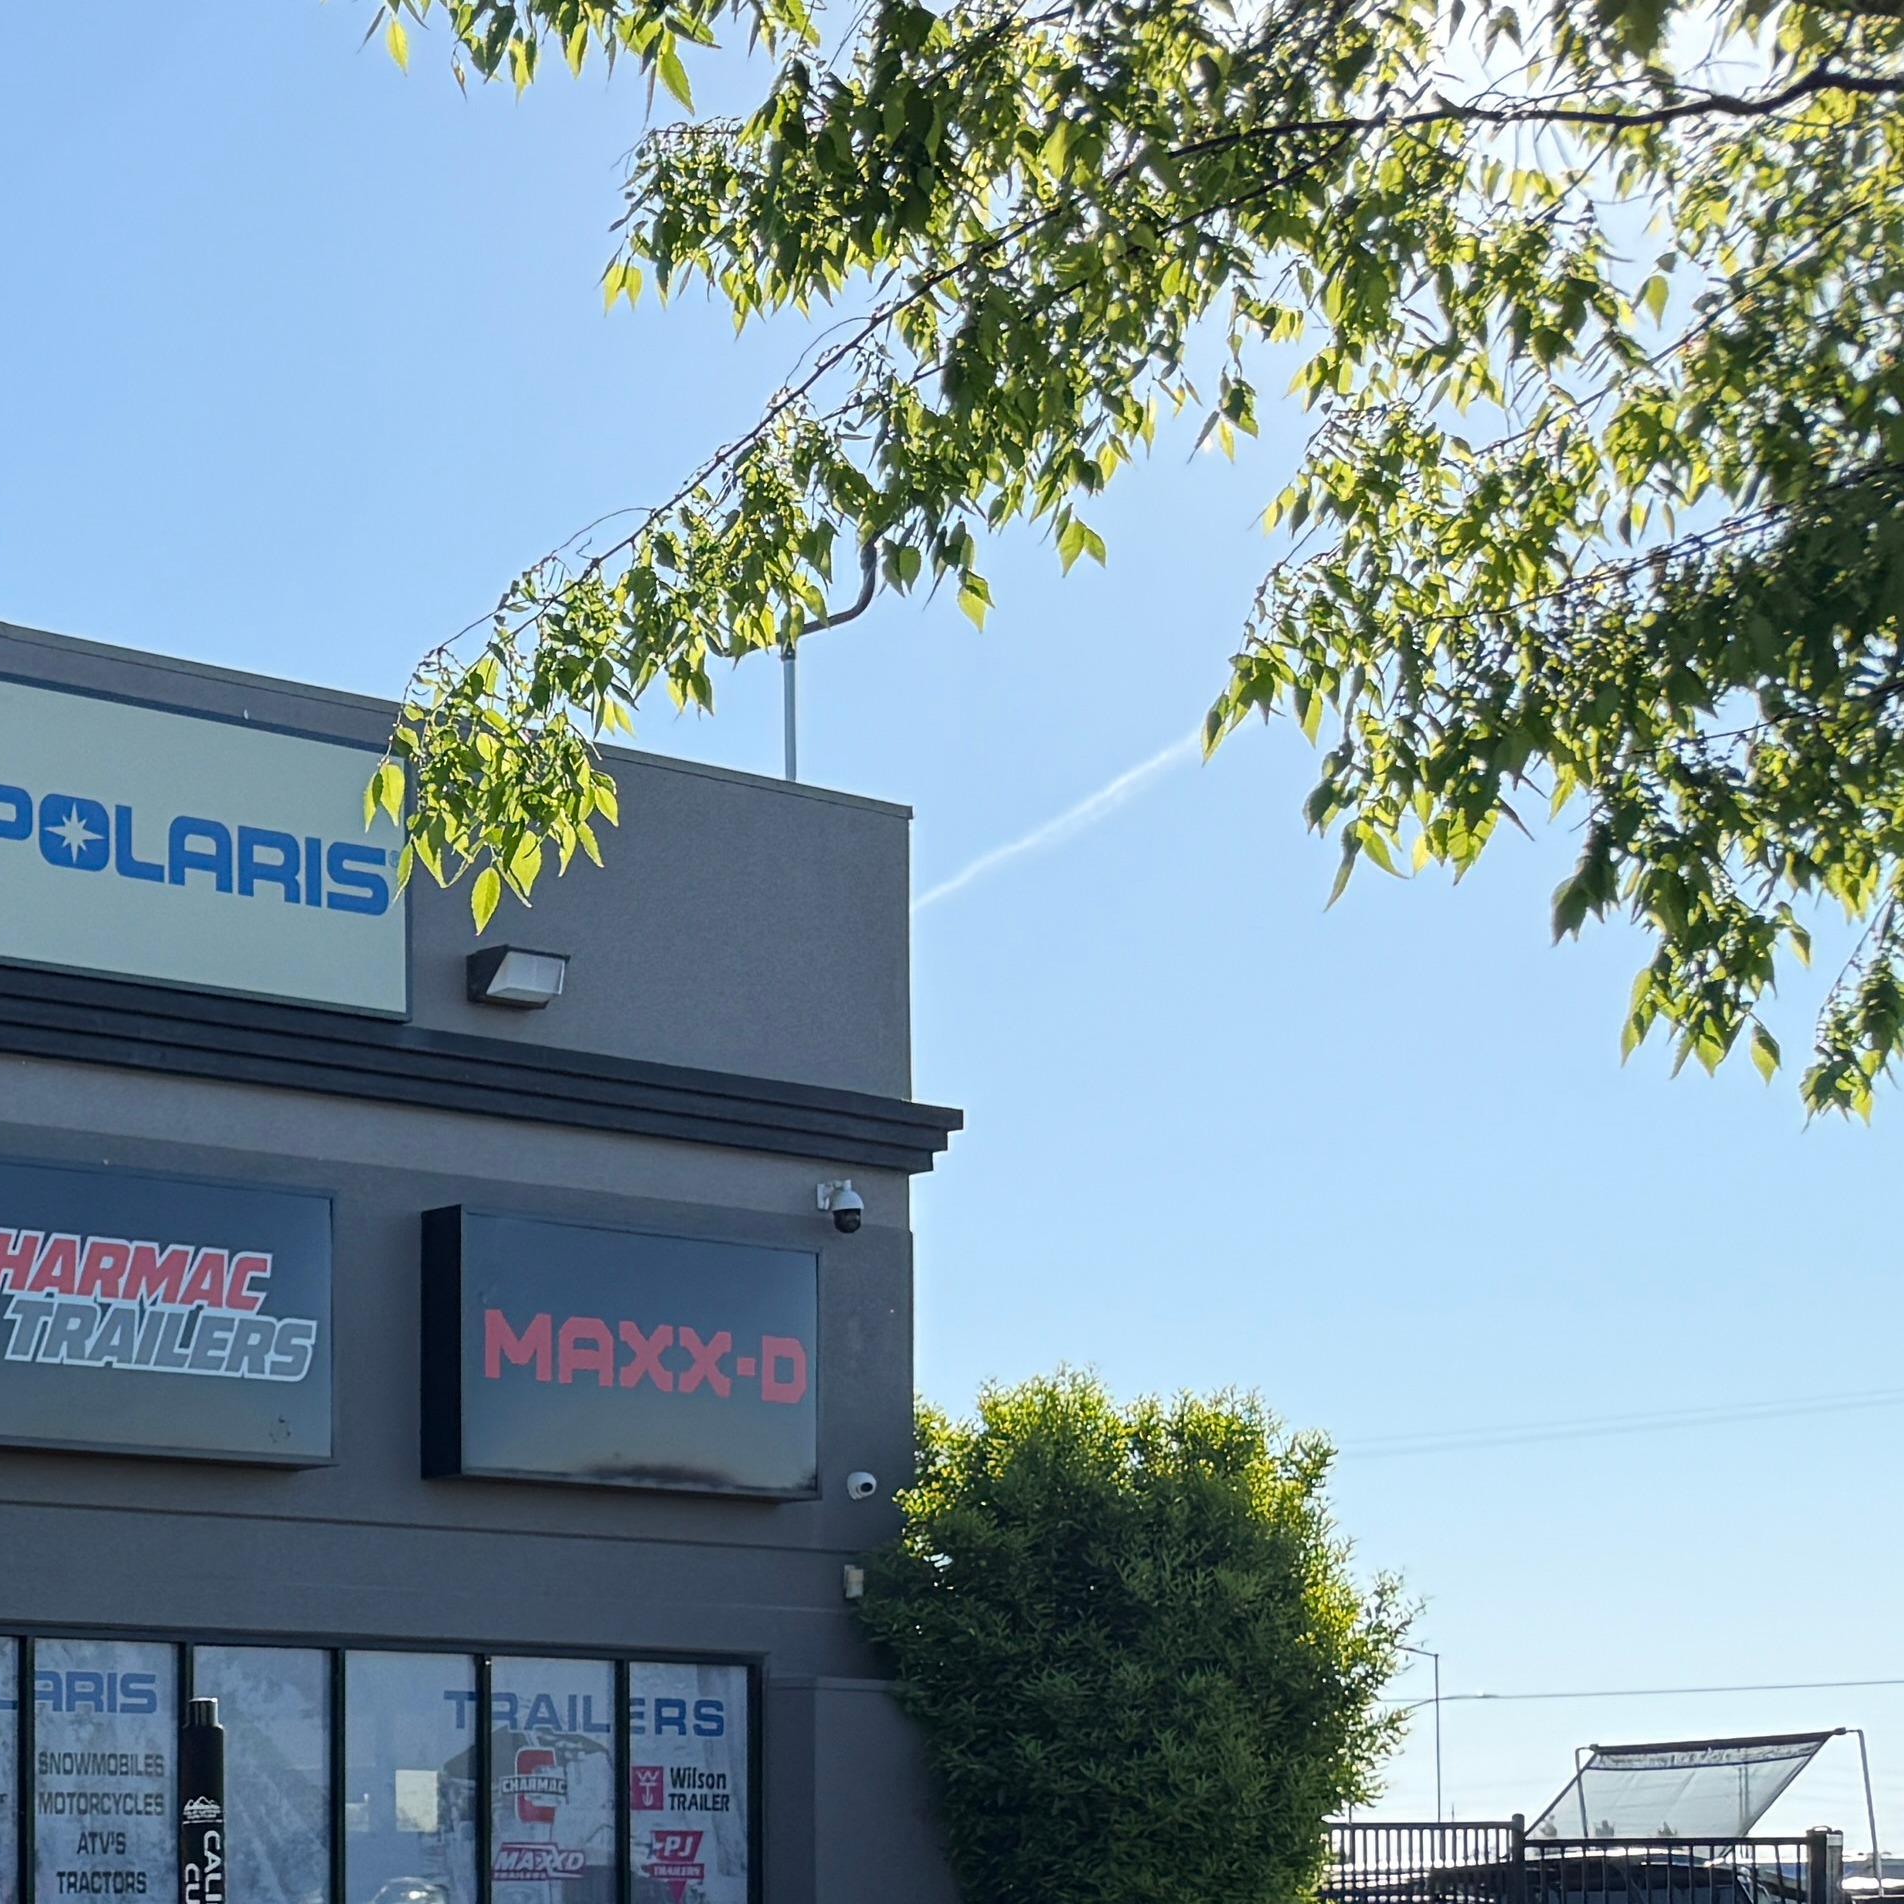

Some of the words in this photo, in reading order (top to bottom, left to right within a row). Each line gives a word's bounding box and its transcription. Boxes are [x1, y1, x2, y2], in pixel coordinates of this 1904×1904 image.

[5, 1297, 318, 1382] TRAILERS
[483, 1308, 808, 1404] MAXX-D
[38, 1751, 165, 1777] SNOWMOBILES
[502, 1777, 567, 1794] CHARMAC
[670, 1767, 727, 1790] Wilson
[38, 1792, 165, 1816] MOTORCYCLES
[668, 1794, 730, 1812] TRAILER
[76, 1831, 127, 1855] ATV'S
[663, 1836, 694, 1857] PJ
[56, 1871, 147, 1894] TRACTORS
